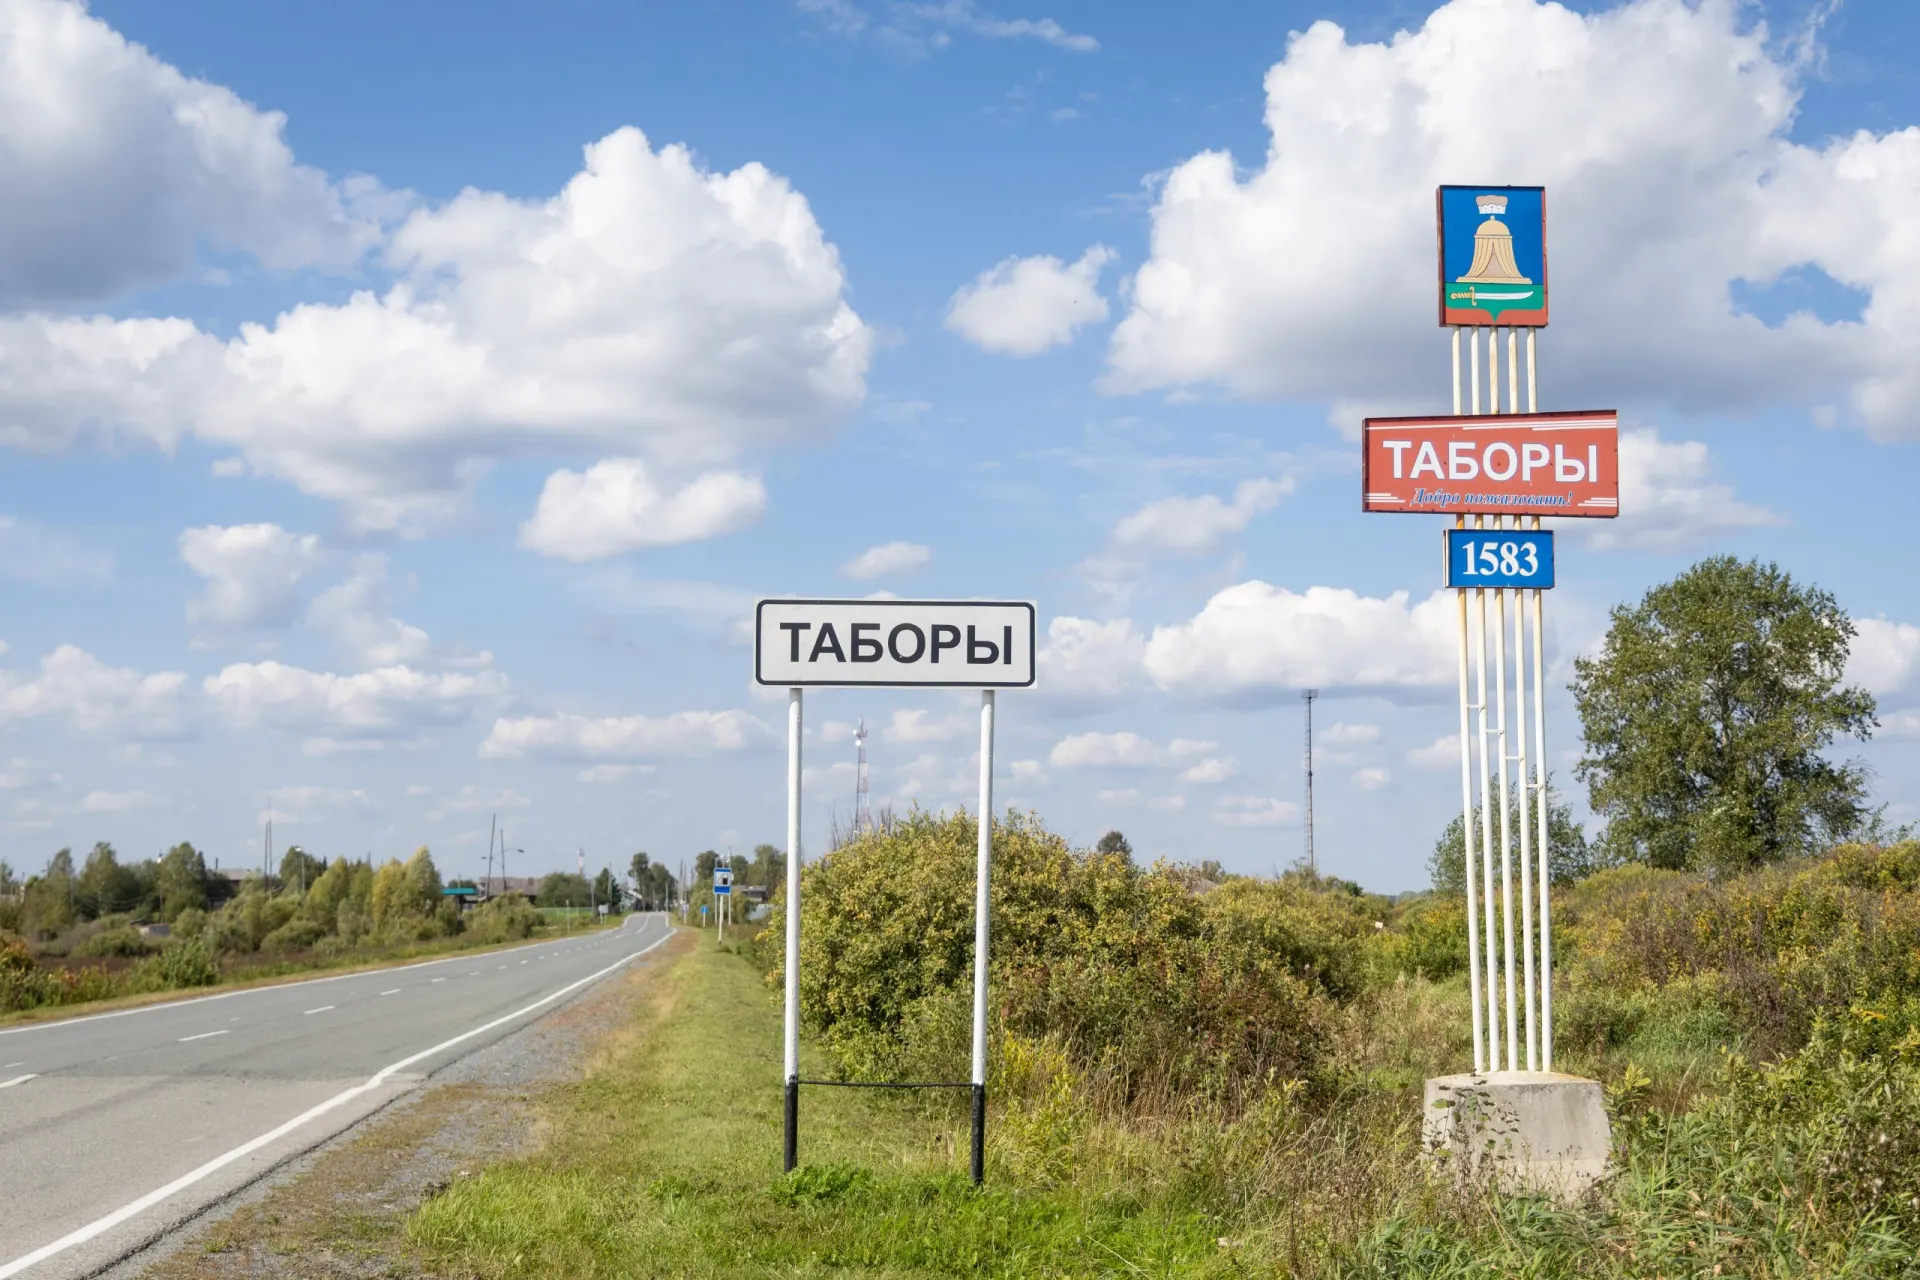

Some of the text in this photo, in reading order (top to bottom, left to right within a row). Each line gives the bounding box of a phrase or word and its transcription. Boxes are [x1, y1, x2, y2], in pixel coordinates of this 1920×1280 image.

[1382, 440, 1599, 483] ТАБОРЫ
[1409, 488, 1573, 508] Добро пожаловать!
[1461, 541, 1539, 577] 1583
[779, 622, 1012, 665] ТАБОРЫ
